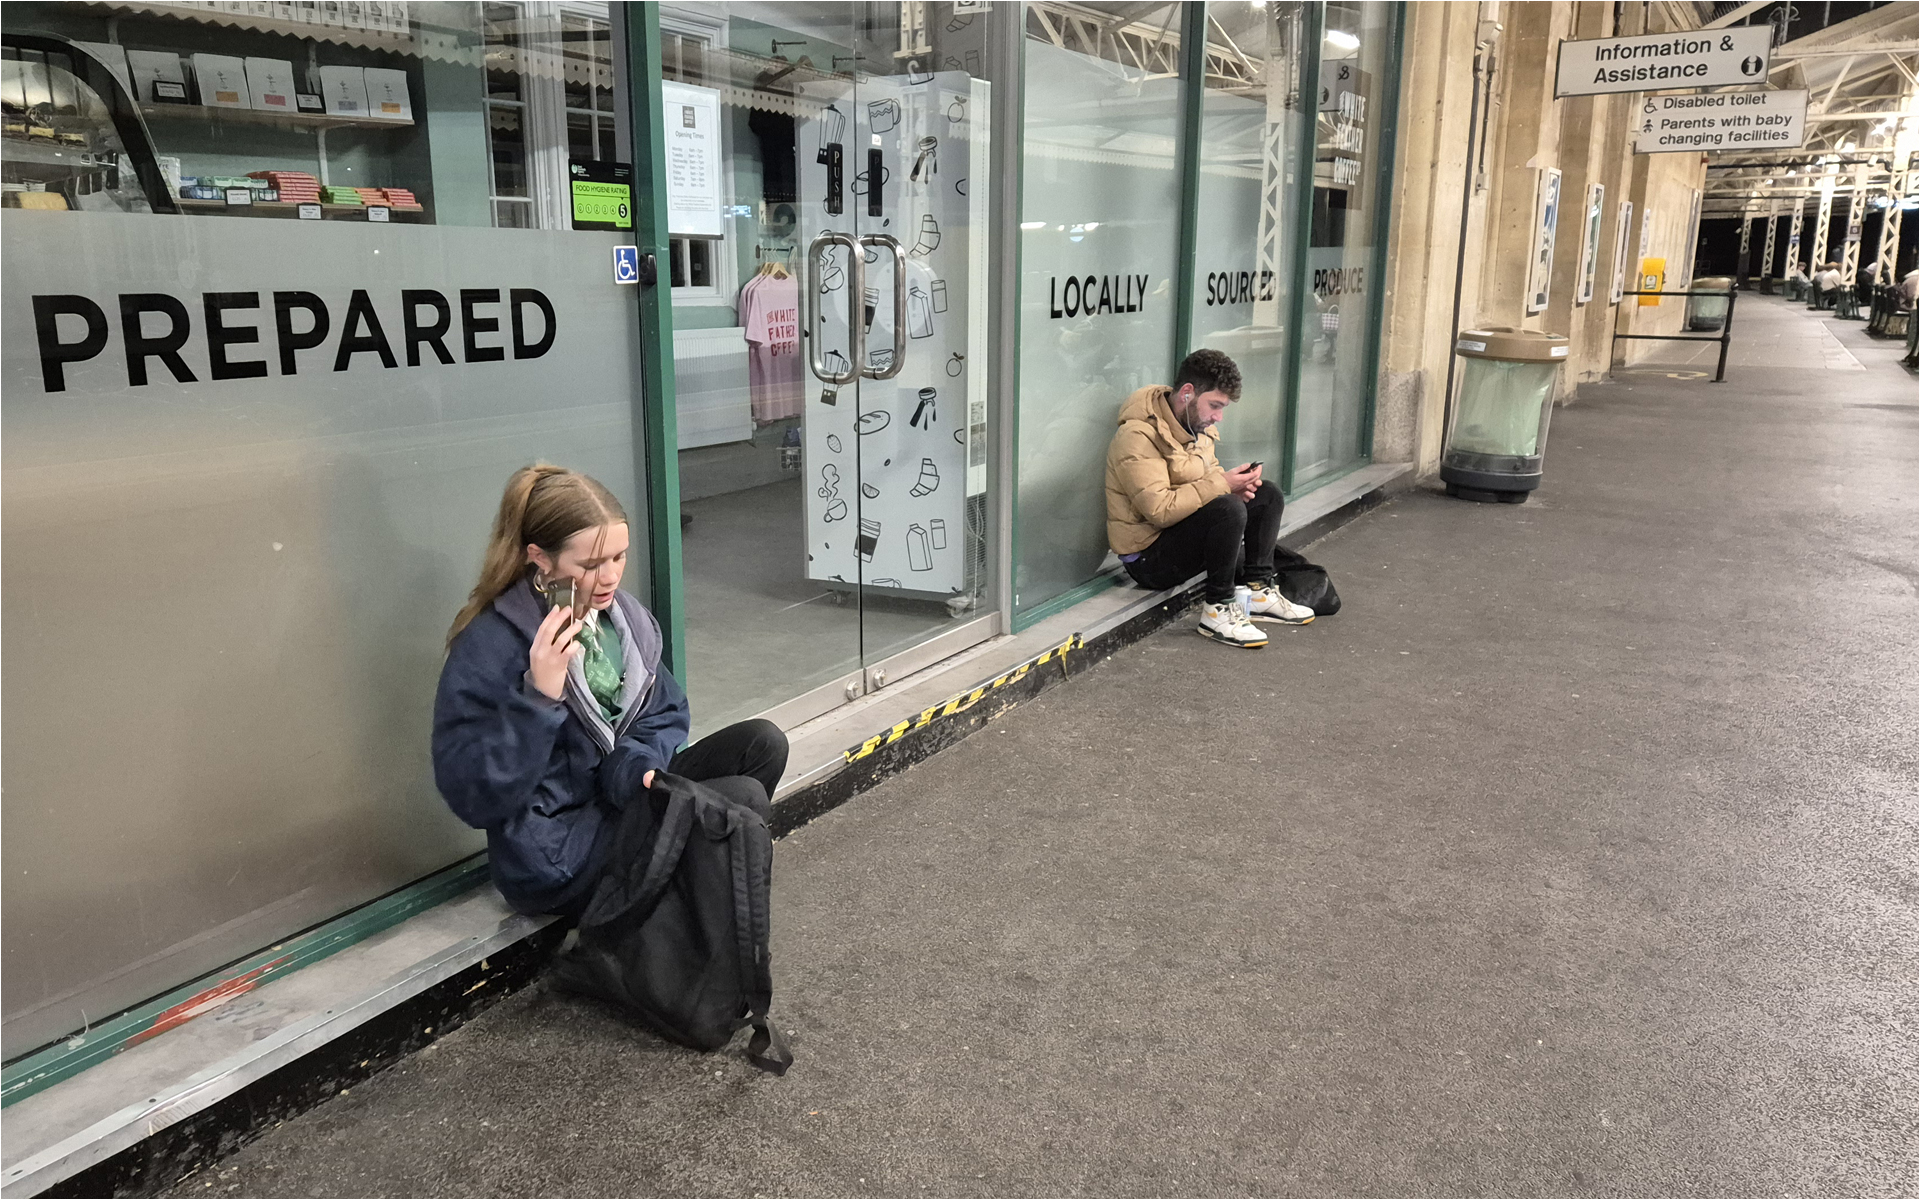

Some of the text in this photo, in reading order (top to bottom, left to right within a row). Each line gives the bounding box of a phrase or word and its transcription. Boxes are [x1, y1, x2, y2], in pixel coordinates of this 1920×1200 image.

[1595, 34, 1735, 62] Information &
[1593, 62, 1709, 84] Assistance
[1663, 93, 1767, 109] Disabled toilet
[1660, 113, 1792, 130] Parents with baby
[675, 130, 705, 140] Opening Times
[1659, 130, 1790, 146] changing facilities
[575, 184, 590, 192] FOOD
[611, 187, 627, 195] RATING
[620, 205, 626, 217] 5
[1206, 270, 1277, 307] SOURCED
[1313, 267, 1364, 297] PRODUCE
[1050, 274, 1149, 319] LOCALLY
[31, 288, 558, 393] PREPARED
